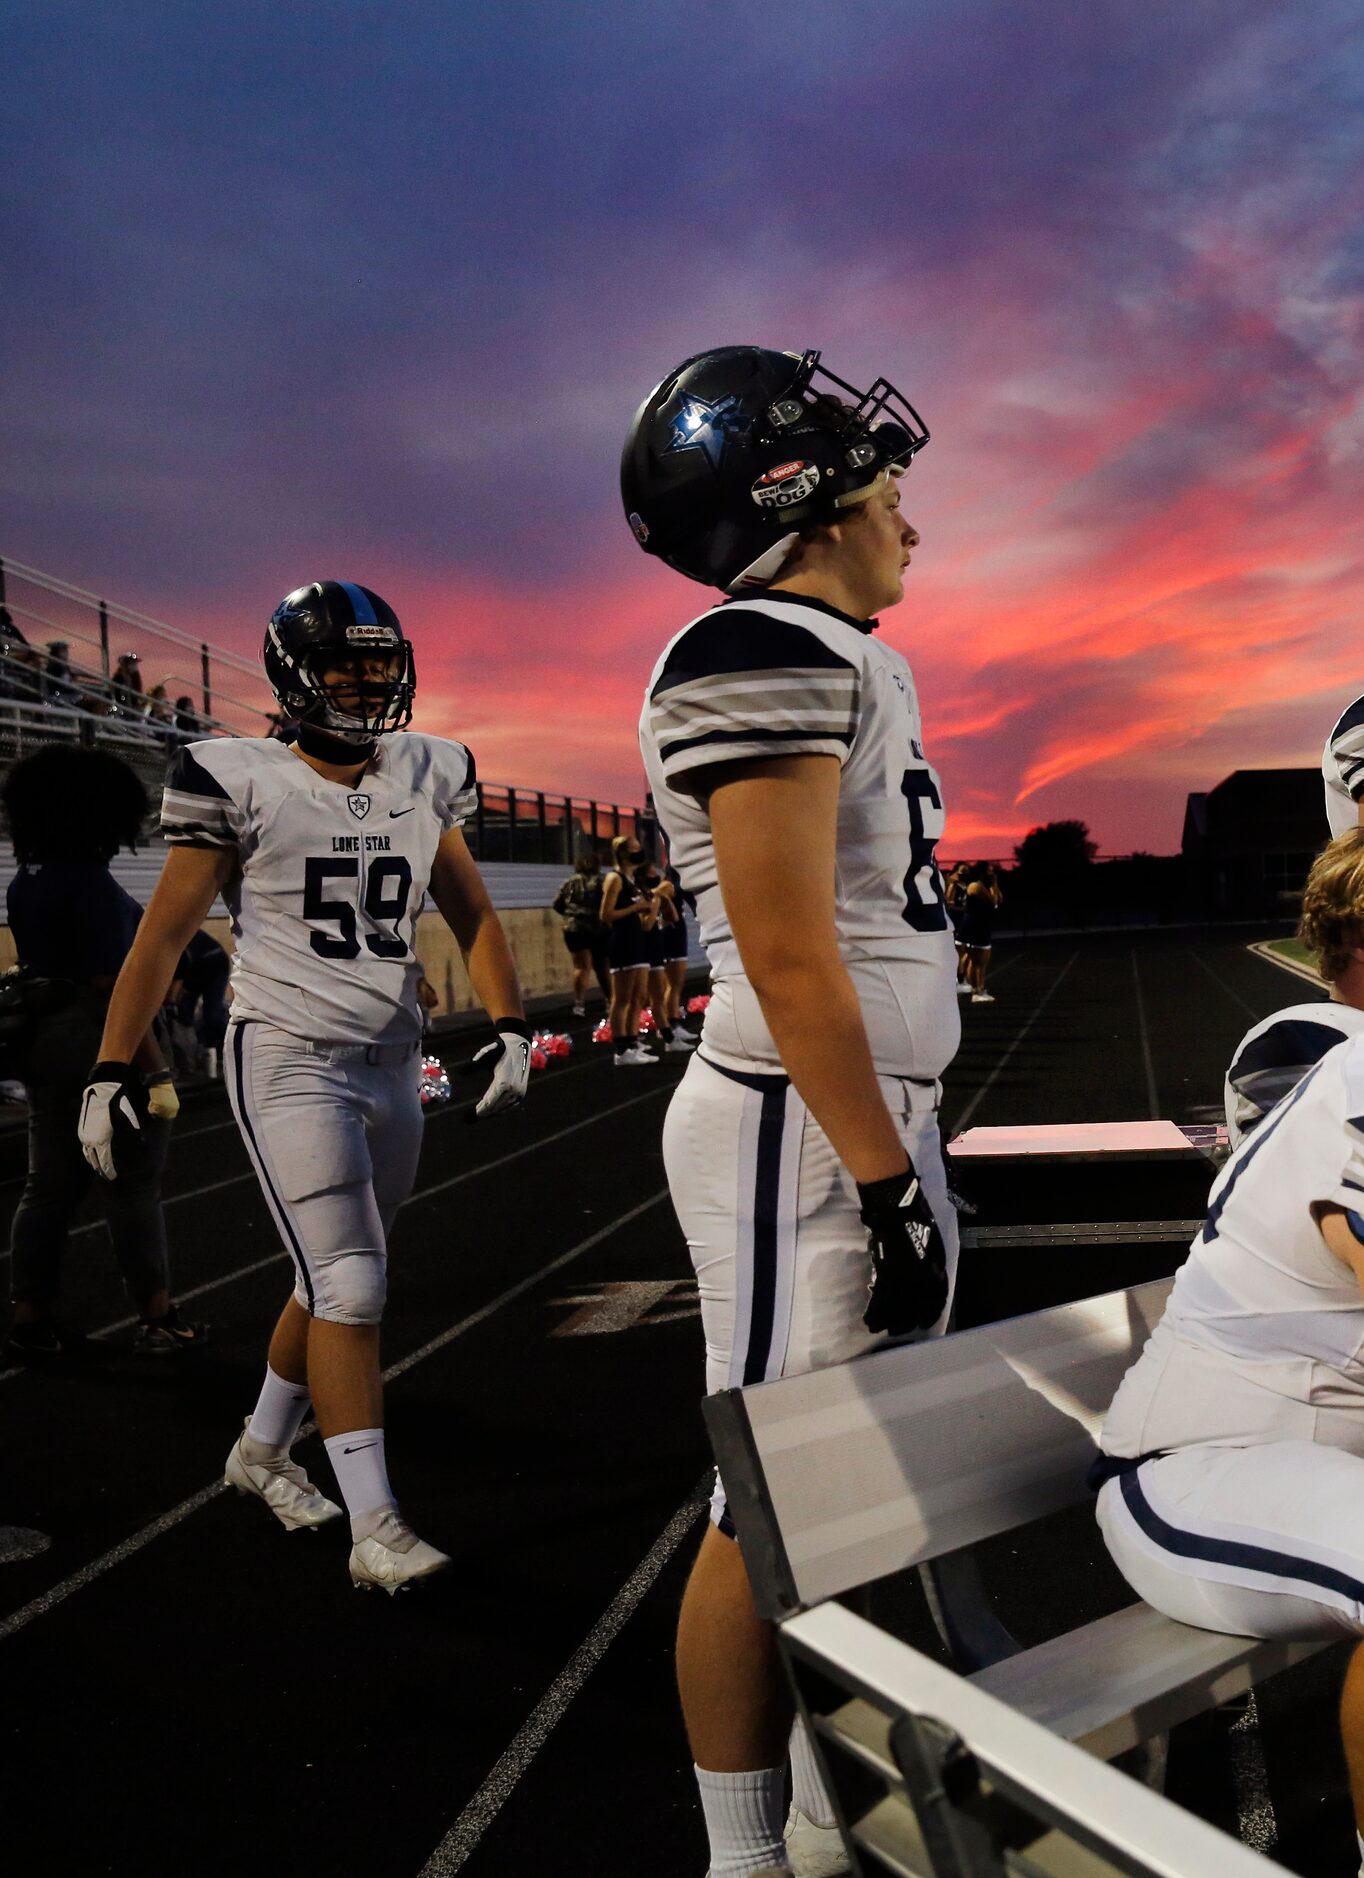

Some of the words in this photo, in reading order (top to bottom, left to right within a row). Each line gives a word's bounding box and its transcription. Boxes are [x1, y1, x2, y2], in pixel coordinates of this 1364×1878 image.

[332, 837, 360, 851] LONE
[365, 836, 391, 851] STAR
[303, 856, 412, 959] 59
